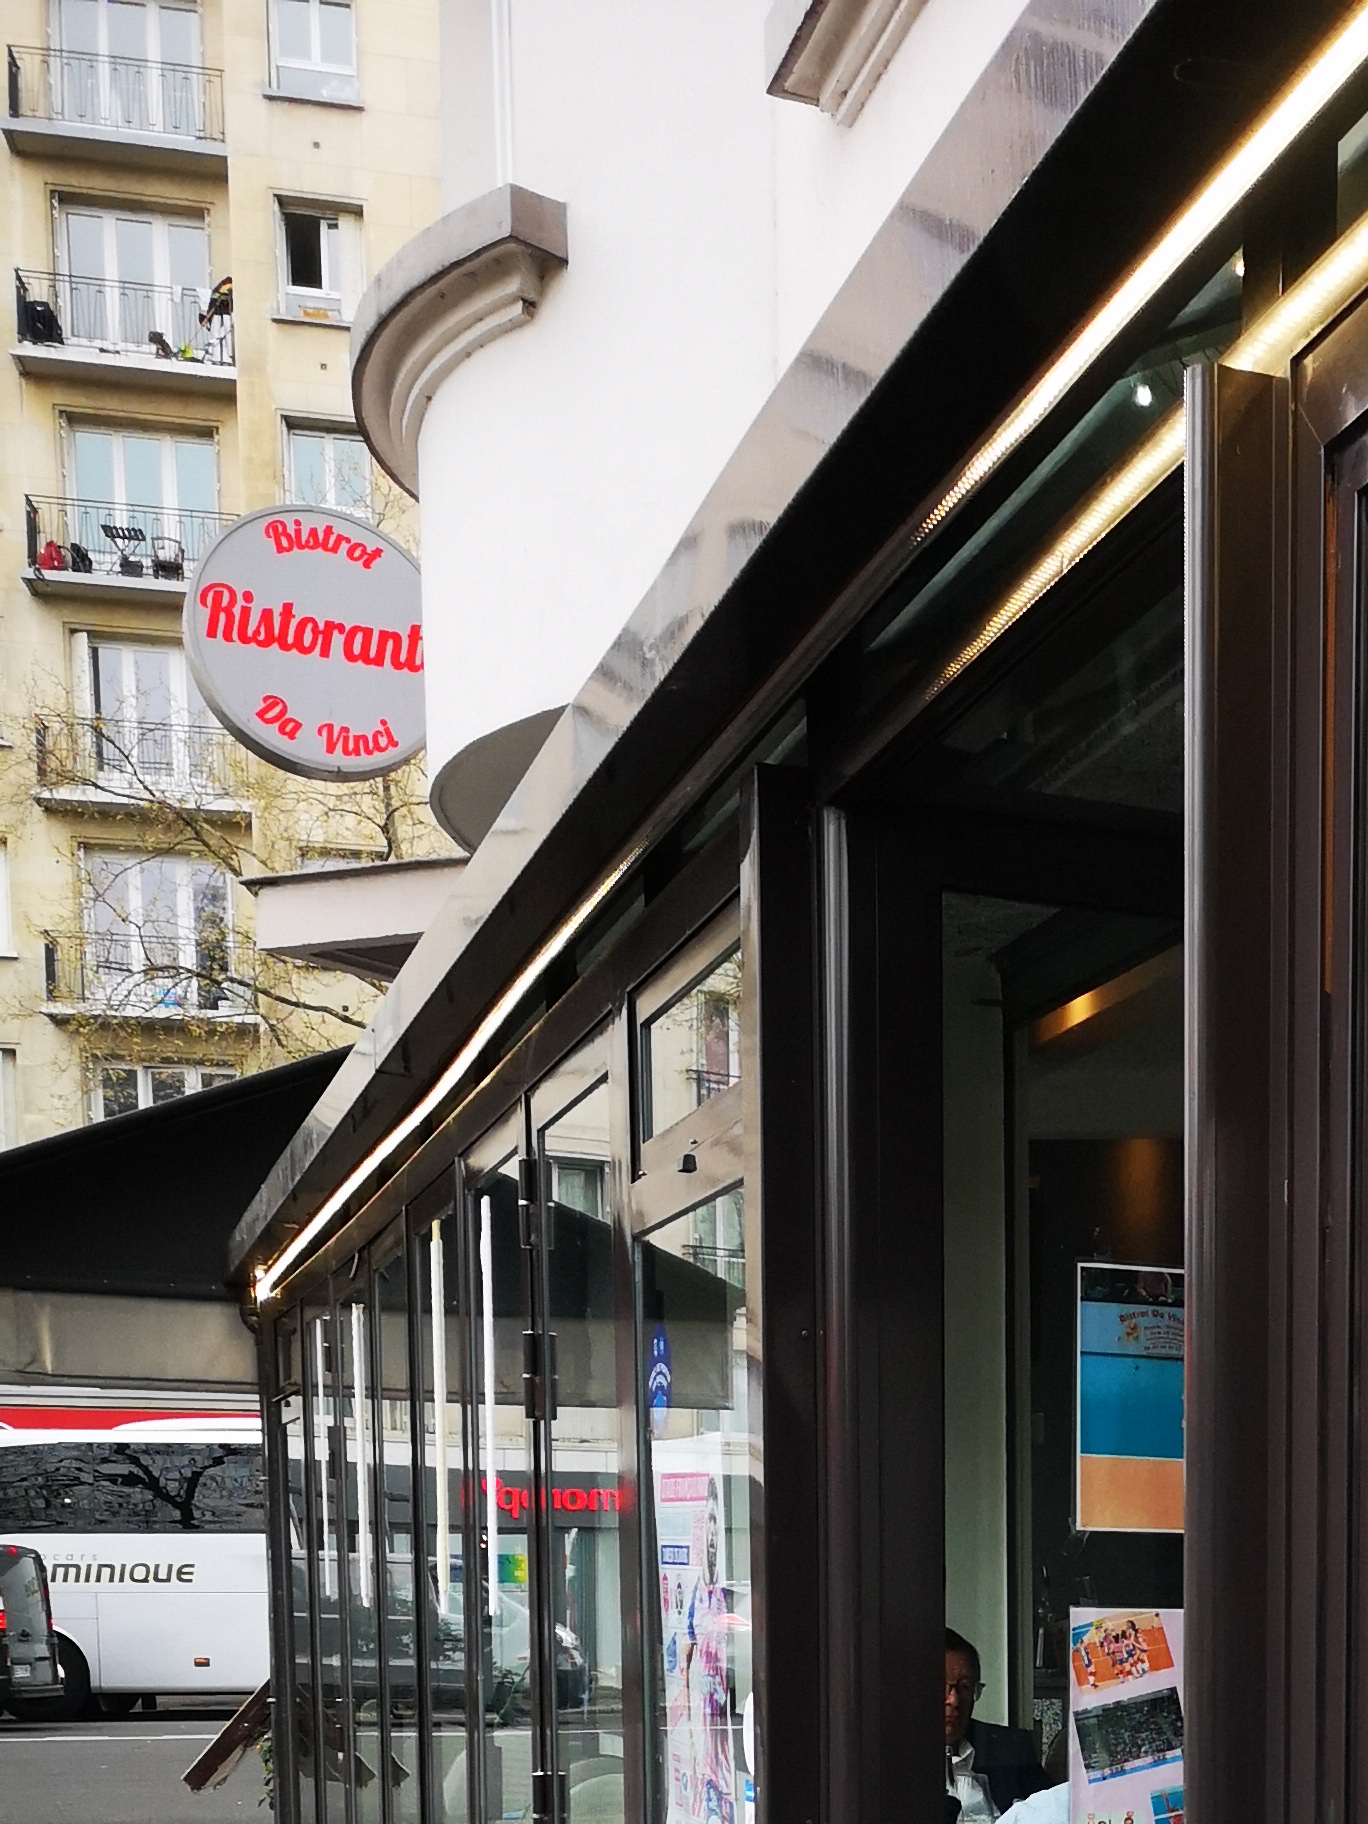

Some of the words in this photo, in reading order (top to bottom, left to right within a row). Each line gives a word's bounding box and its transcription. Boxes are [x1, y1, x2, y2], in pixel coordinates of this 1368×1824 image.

[264, 518, 384, 570] Bistrot
[254, 694, 303, 741] Da
[317, 718, 399, 757] Vinci
